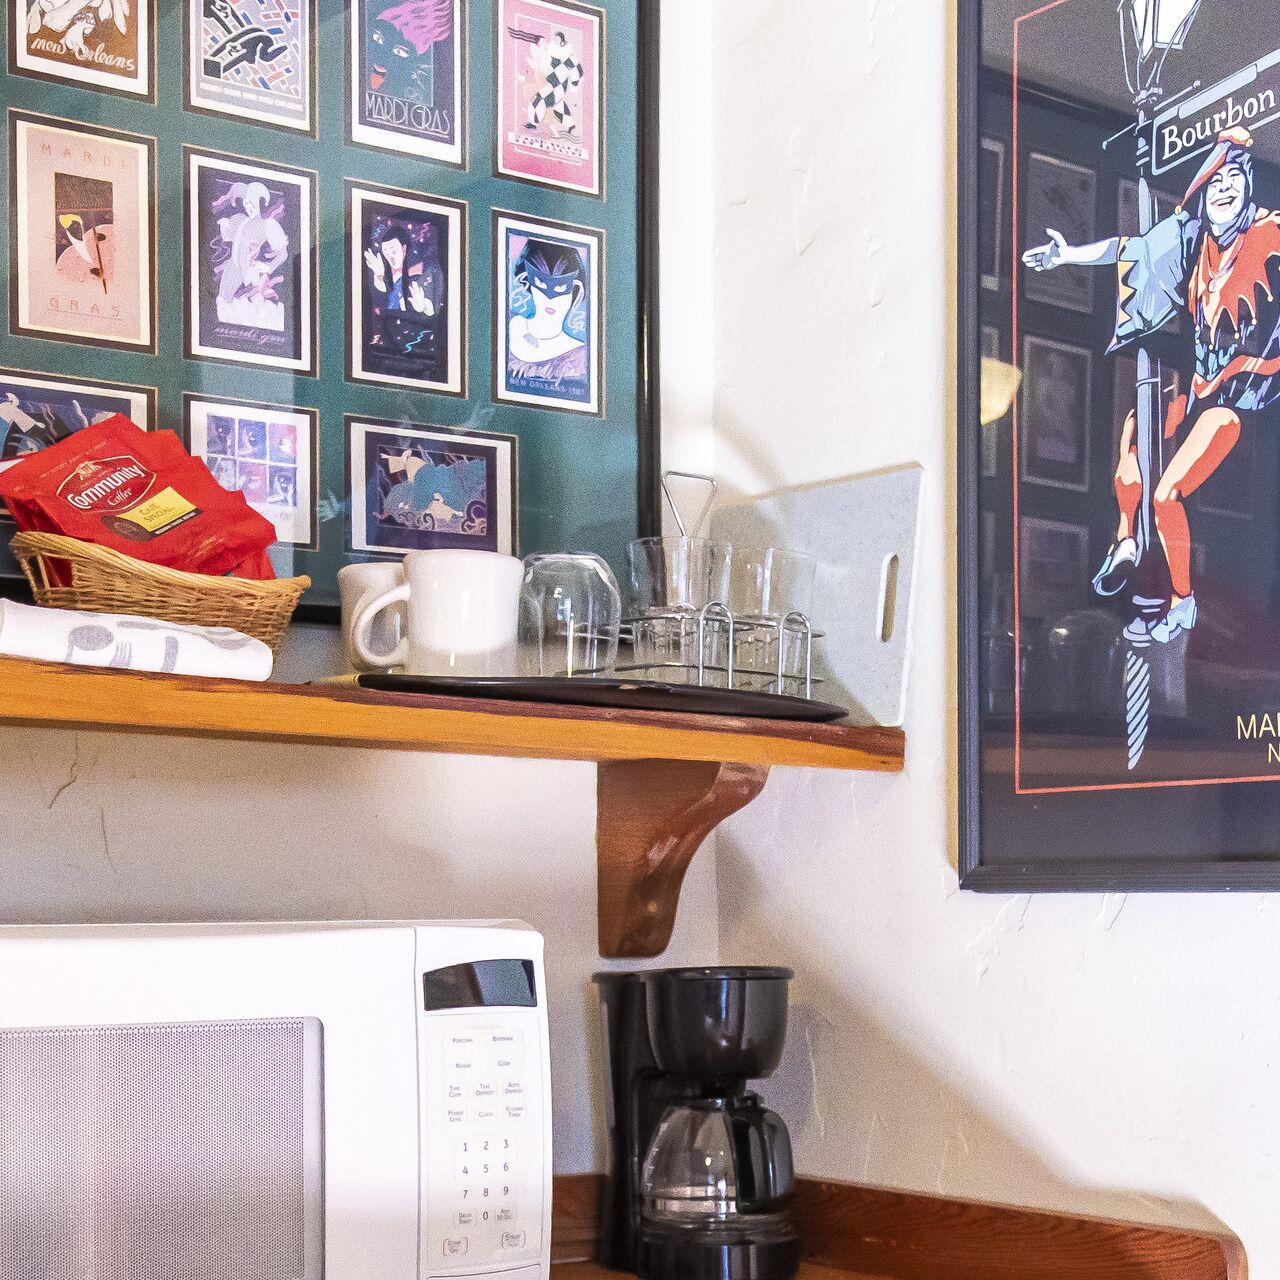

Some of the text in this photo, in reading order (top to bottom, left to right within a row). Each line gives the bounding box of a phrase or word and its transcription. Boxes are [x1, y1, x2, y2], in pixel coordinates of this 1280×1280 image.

[411, 105, 451, 135] GRAS
[1161, 89, 1277, 160] Bourbon
[49, 297, 120, 317] GRAS
[67, 465, 145, 509] Community
[483, 1141, 489, 1150] 2
[503, 1139, 509, 1148] 3
[462, 1162, 509, 1174] 4 5 6
[483, 1188, 489, 1197] 8
[503, 1186, 509, 1195] 9
[482, 1211, 489, 1220] 0
